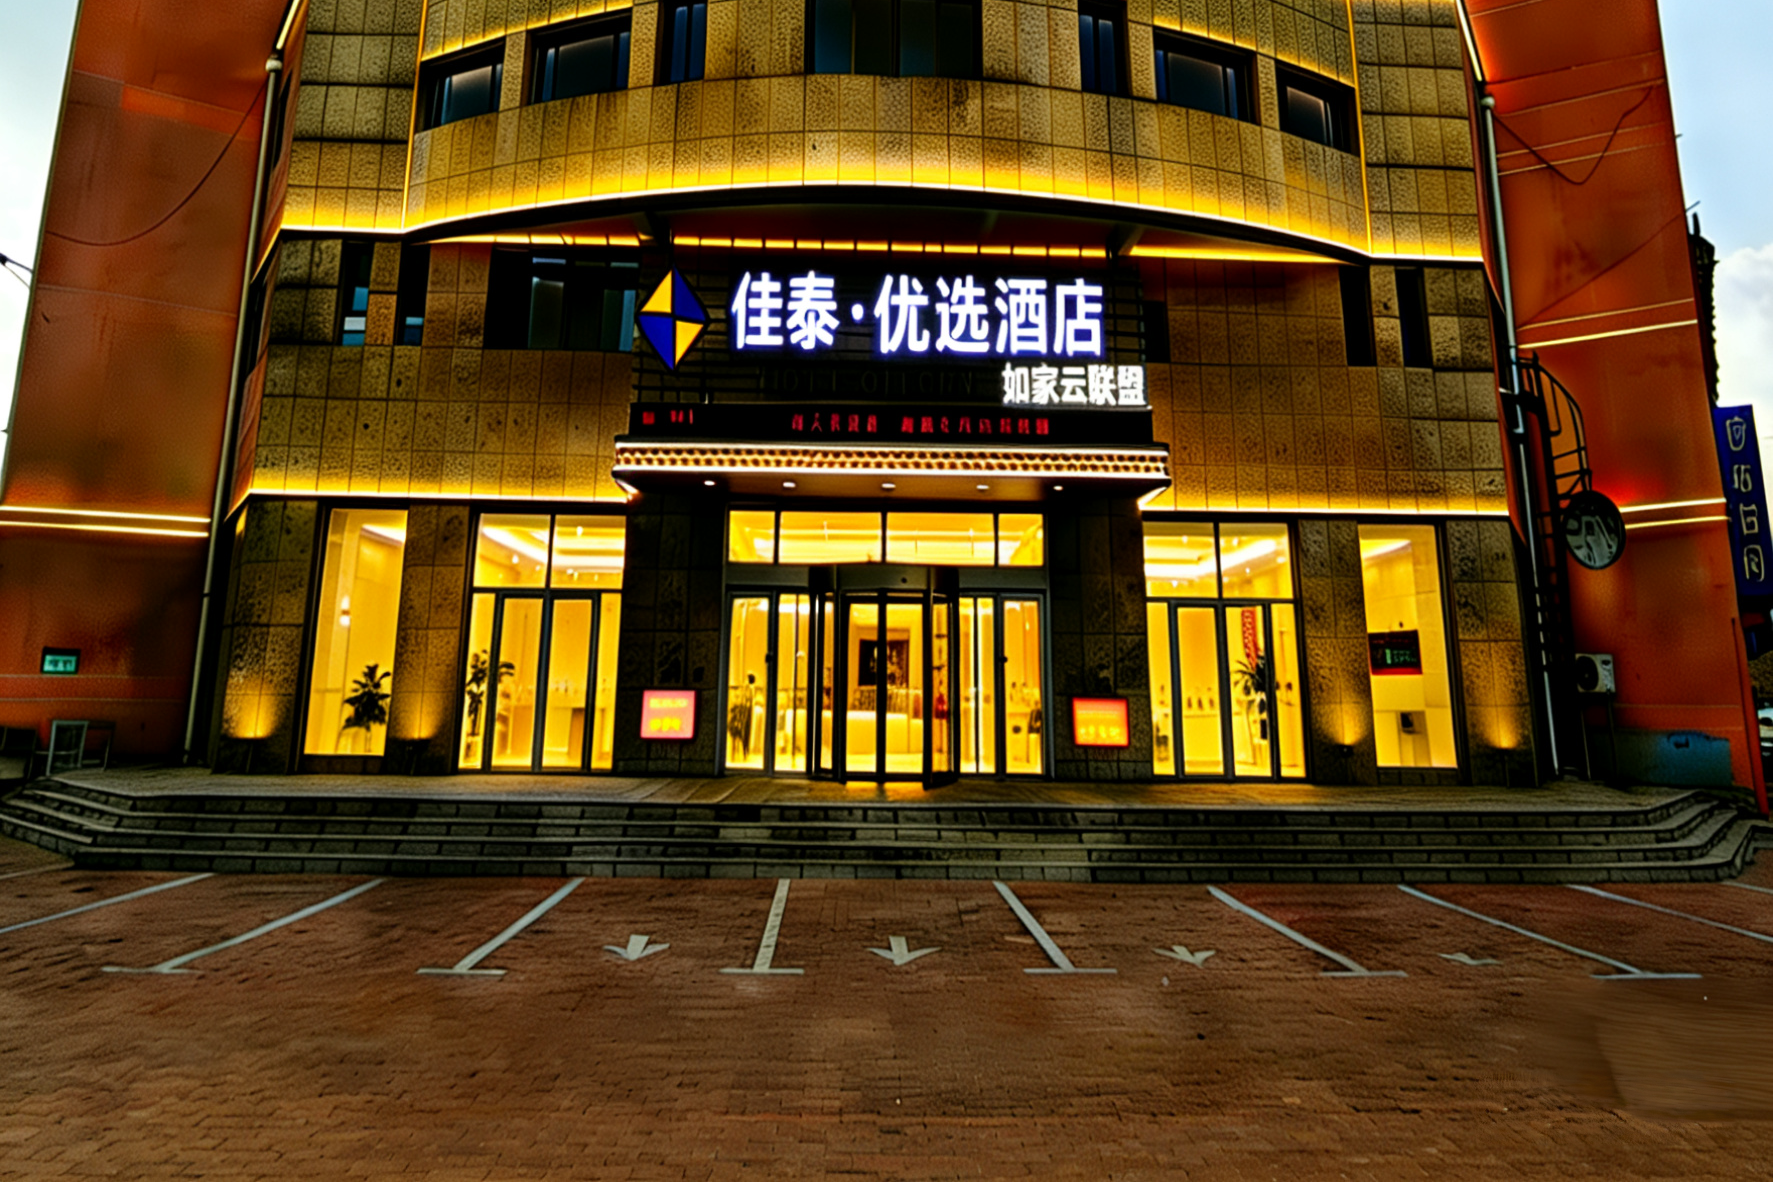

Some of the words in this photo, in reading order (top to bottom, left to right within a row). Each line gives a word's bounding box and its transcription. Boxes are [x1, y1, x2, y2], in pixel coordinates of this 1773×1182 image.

[731, 270, 1104, 357] 佳泰·优选酒店
[1001, 362, 1148, 407] 如家云联盟
